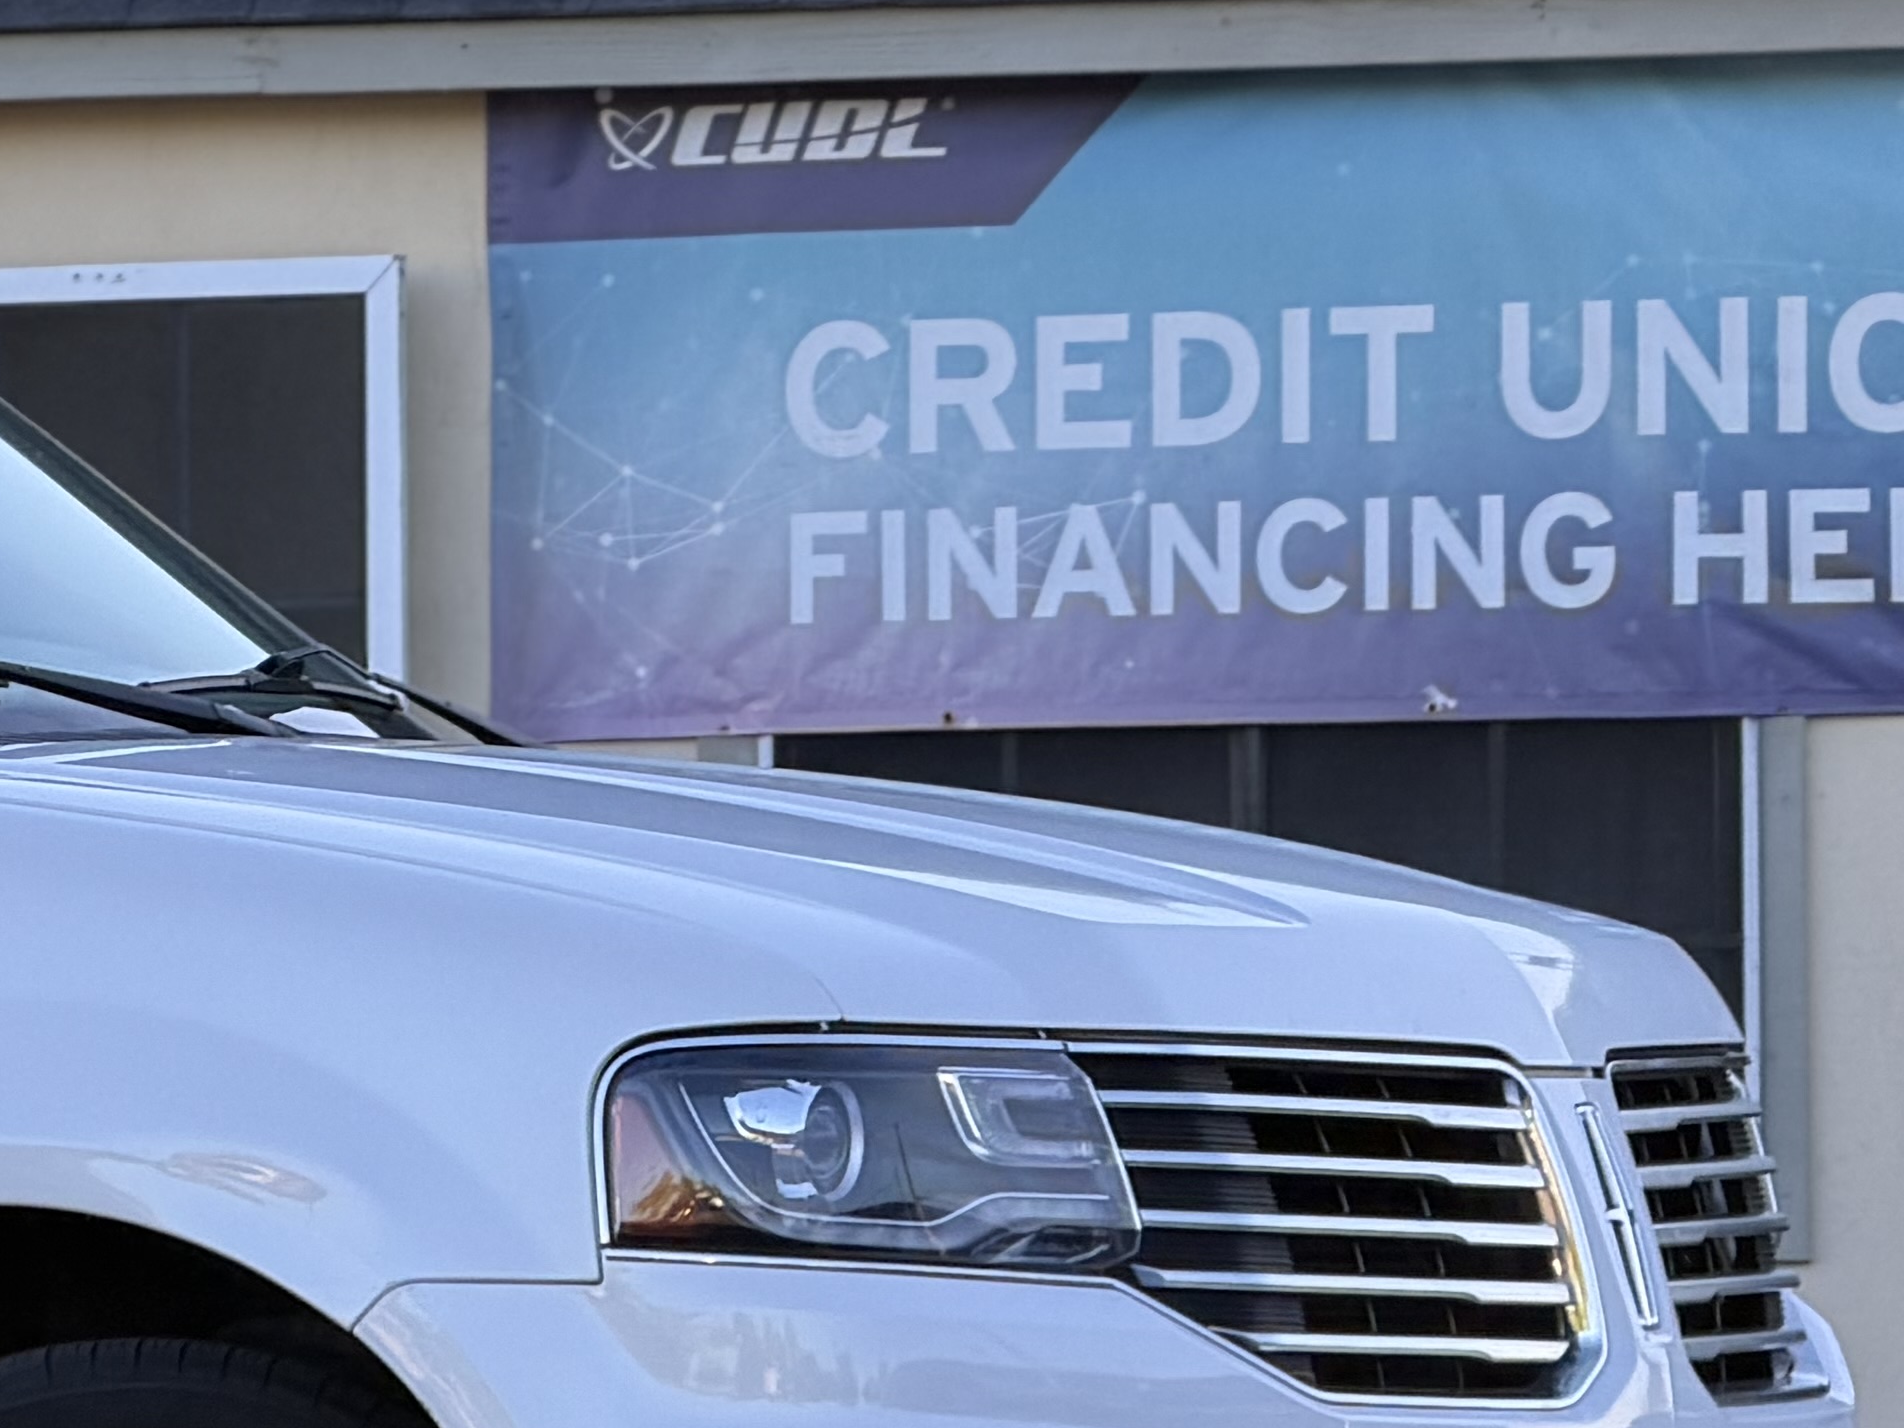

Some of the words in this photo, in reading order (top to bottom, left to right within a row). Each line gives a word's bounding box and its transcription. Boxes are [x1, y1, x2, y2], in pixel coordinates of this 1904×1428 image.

[670, 97, 948, 167] CUDL
[785, 303, 1435, 458] CREDIT
[789, 490, 1617, 625] FINANCING
[1672, 486, 1904, 606] HE
